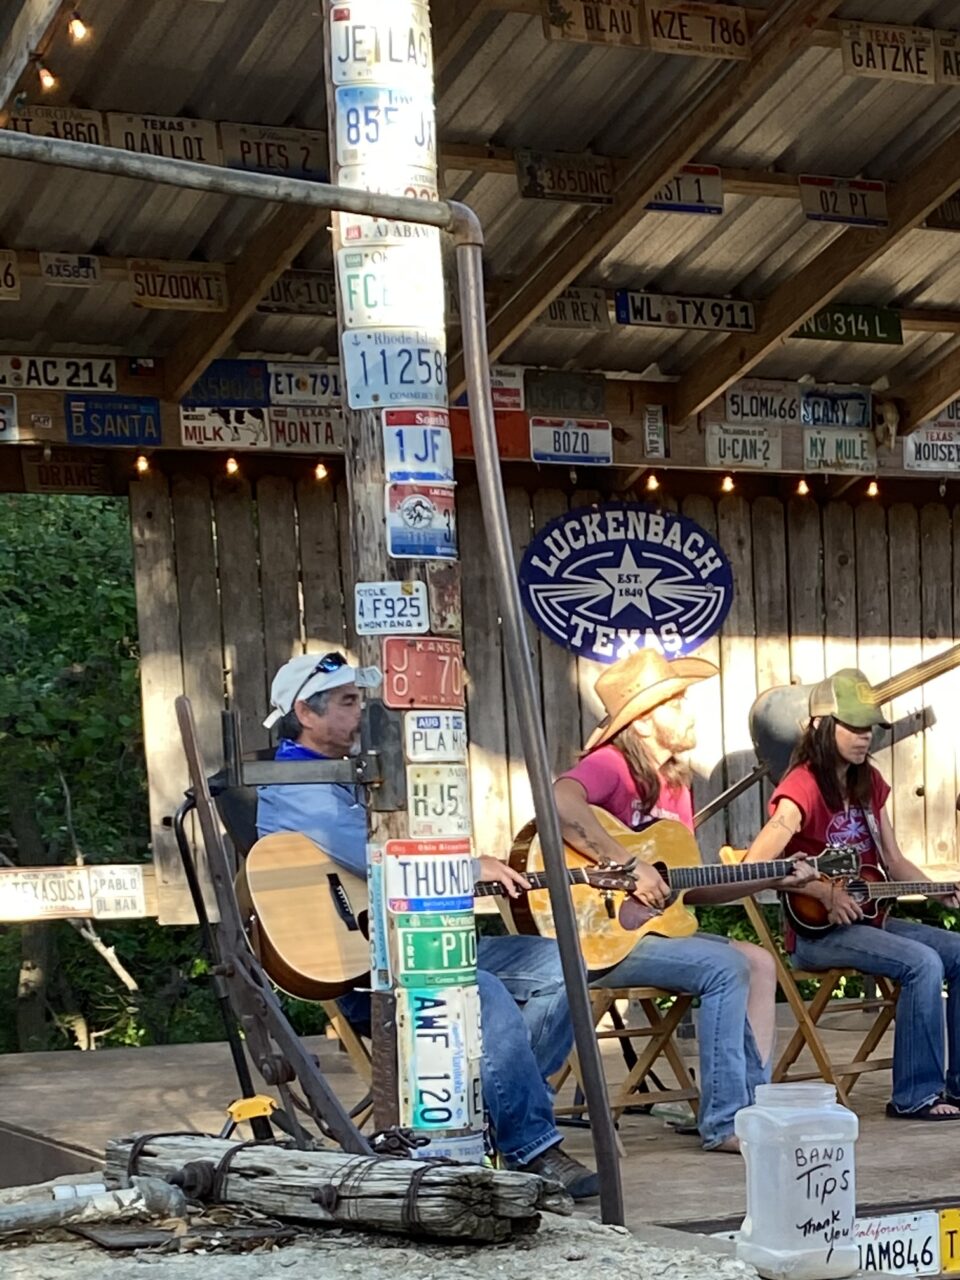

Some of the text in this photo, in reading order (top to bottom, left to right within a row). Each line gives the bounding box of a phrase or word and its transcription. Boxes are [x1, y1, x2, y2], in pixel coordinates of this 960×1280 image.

[650, 9, 747, 47] KZE 786
[868, 29, 906, 45] TEXAS
[850, 40, 929, 75] GATZKE
[141, 118, 185, 133] TEXAS
[239, 139, 314, 172] PIES 2
[628, 294, 754, 331] WL TX 911
[833, 314, 870, 337] 314
[26, 359, 114, 389] AC 214
[274, 373, 294, 395] ET
[91, 410, 158, 439] SANTA
[802, 398, 849, 426] SCARY
[184, 425, 224, 442] MILK
[925, 431, 954, 442] TEXAS
[530, 510, 723, 580] LUCKENBACH
[617, 574, 642, 585] EST.
[618, 586, 643, 599] 1849
[363, 619, 413, 629] MONTANA
[568, 614, 684, 660] TEXAS
[418, 717, 440, 728] AUG
[414, 996, 453, 1124] AWF 120
[795, 1147, 845, 1168] BAND
[796, 1163, 850, 1205] Tips
[796, 1210, 841, 1239] Thank
